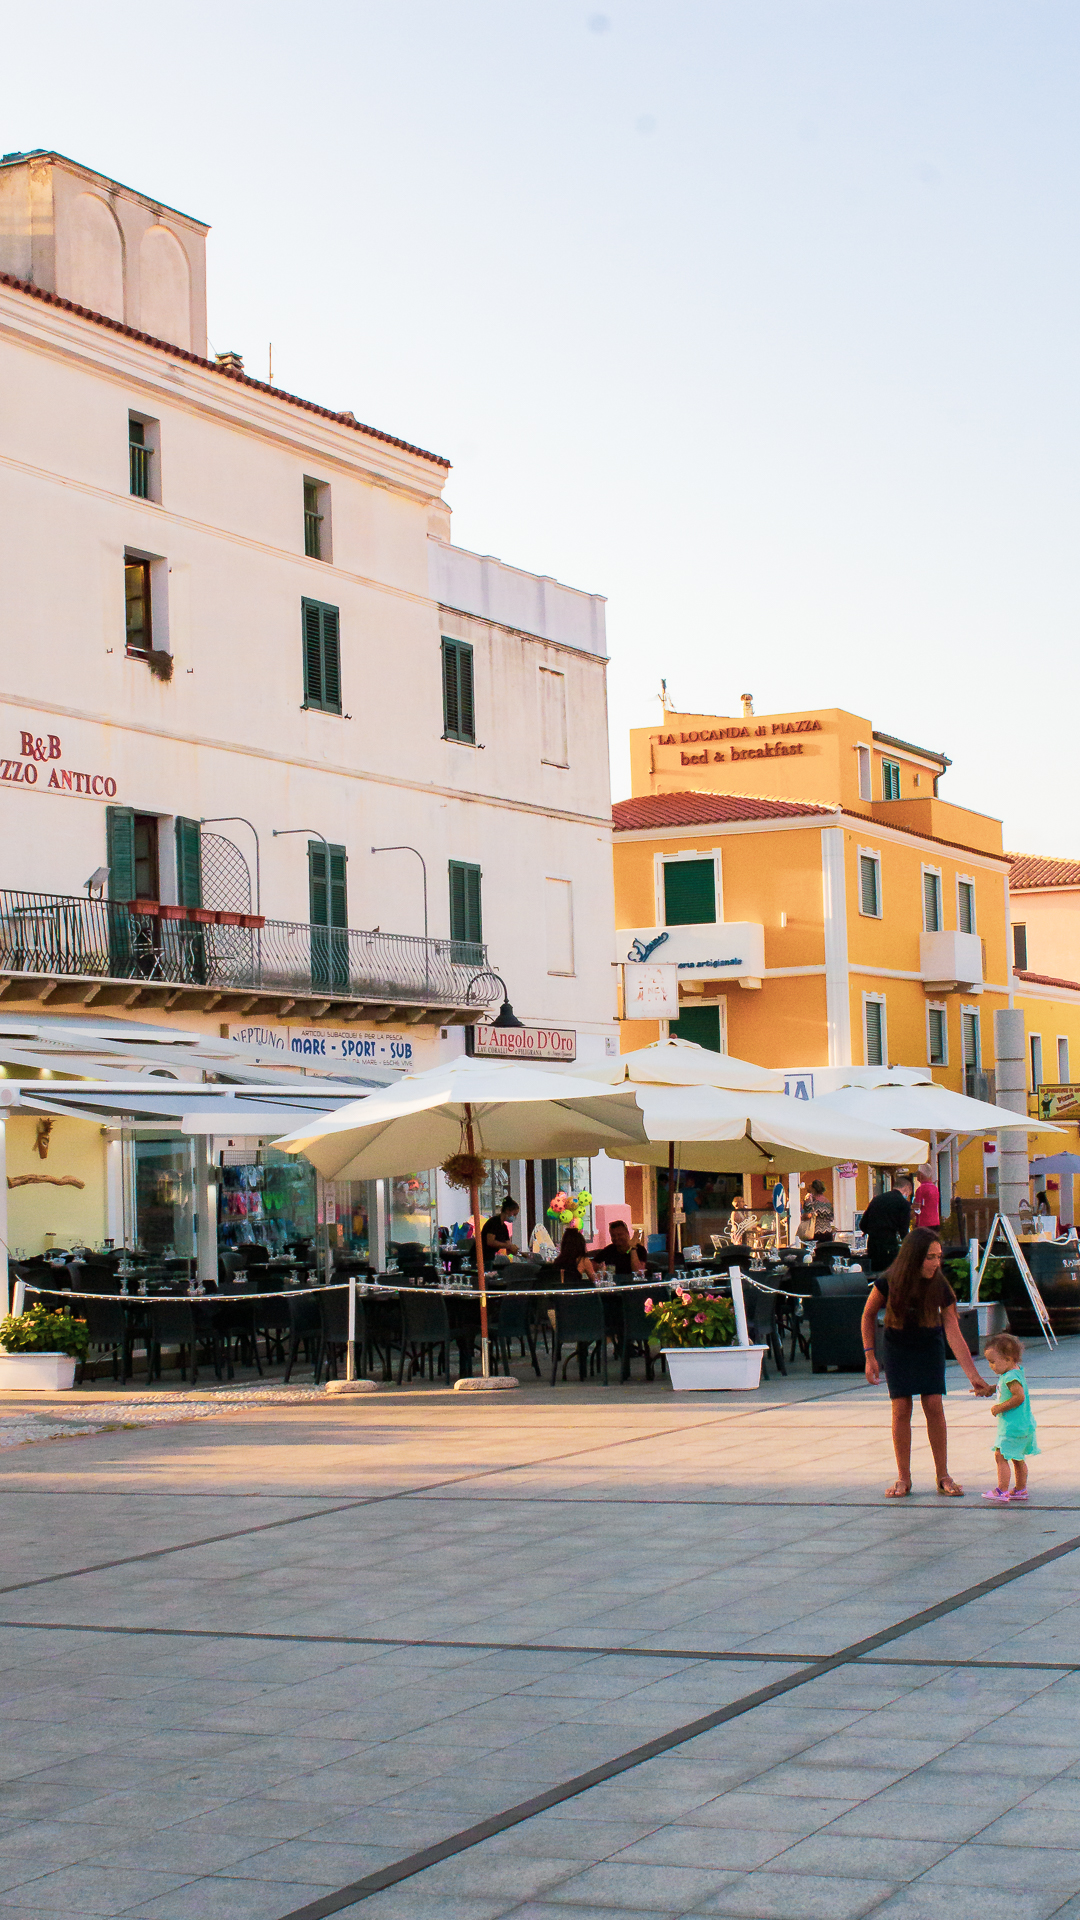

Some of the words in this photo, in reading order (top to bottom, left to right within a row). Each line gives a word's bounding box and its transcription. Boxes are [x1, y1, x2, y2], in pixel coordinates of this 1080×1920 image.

[658, 734, 676, 745] LA
[680, 727, 750, 743] LOCANDA
[754, 726, 766, 736] di
[771, 720, 822, 735] PIAZZA
[19, 731, 62, 762] B&B
[680, 749, 709, 766] bed
[713, 752, 725, 762] &
[730, 741, 804, 761] breakfast
[48, 768, 117, 797] ANTICO
[232, 1027, 285, 1050] NEPTUNO
[291, 1038, 326, 1055] MARE
[341, 1040, 376, 1057] SPORT
[390, 1042, 412, 1059] SUB
[537, 1030, 574, 1051] D'Oro
